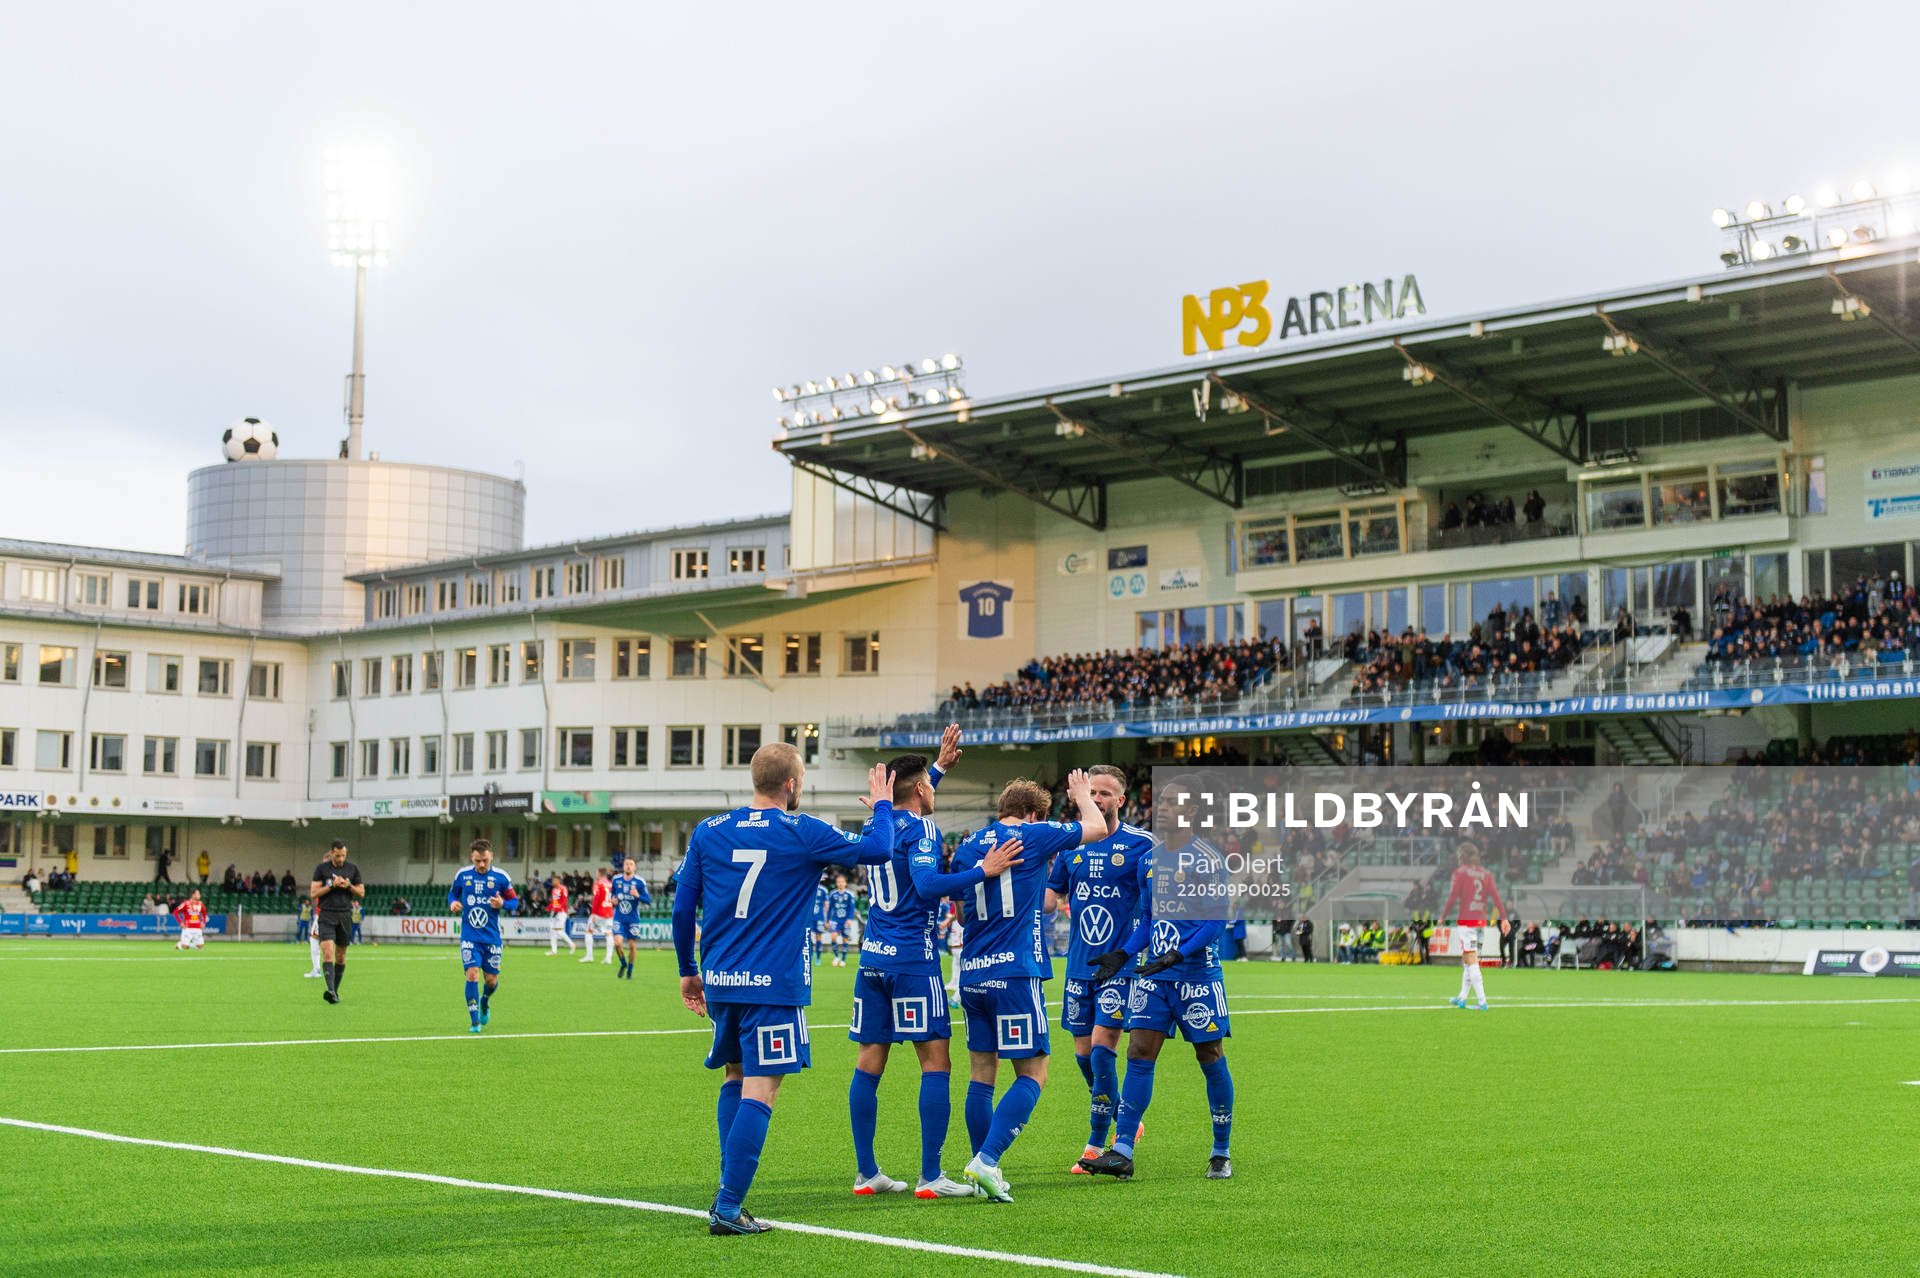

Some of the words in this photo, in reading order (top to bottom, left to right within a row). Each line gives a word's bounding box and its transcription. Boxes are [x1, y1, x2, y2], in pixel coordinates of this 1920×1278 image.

[1182, 280, 1272, 356] NP3
[1280, 274, 1425, 339] ARENA
[977, 597, 996, 617] 10
[1444, 702, 1543, 718] Tillsammans
[1592, 695, 1618, 711] GIF
[455, 794, 484, 812] LADS
[732, 849, 768, 919] 7
[1093, 886, 1121, 899] SCA
[1159, 900, 1187, 913] SCA
[401, 918, 447, 934] RICOH
[924, 910, 935, 961] stadium
[1032, 909, 1043, 963] stadium
[802, 927, 811, 986] stadium
[705, 970, 771, 987] Molinbil.se
[1180, 982, 1210, 1001] Diös
